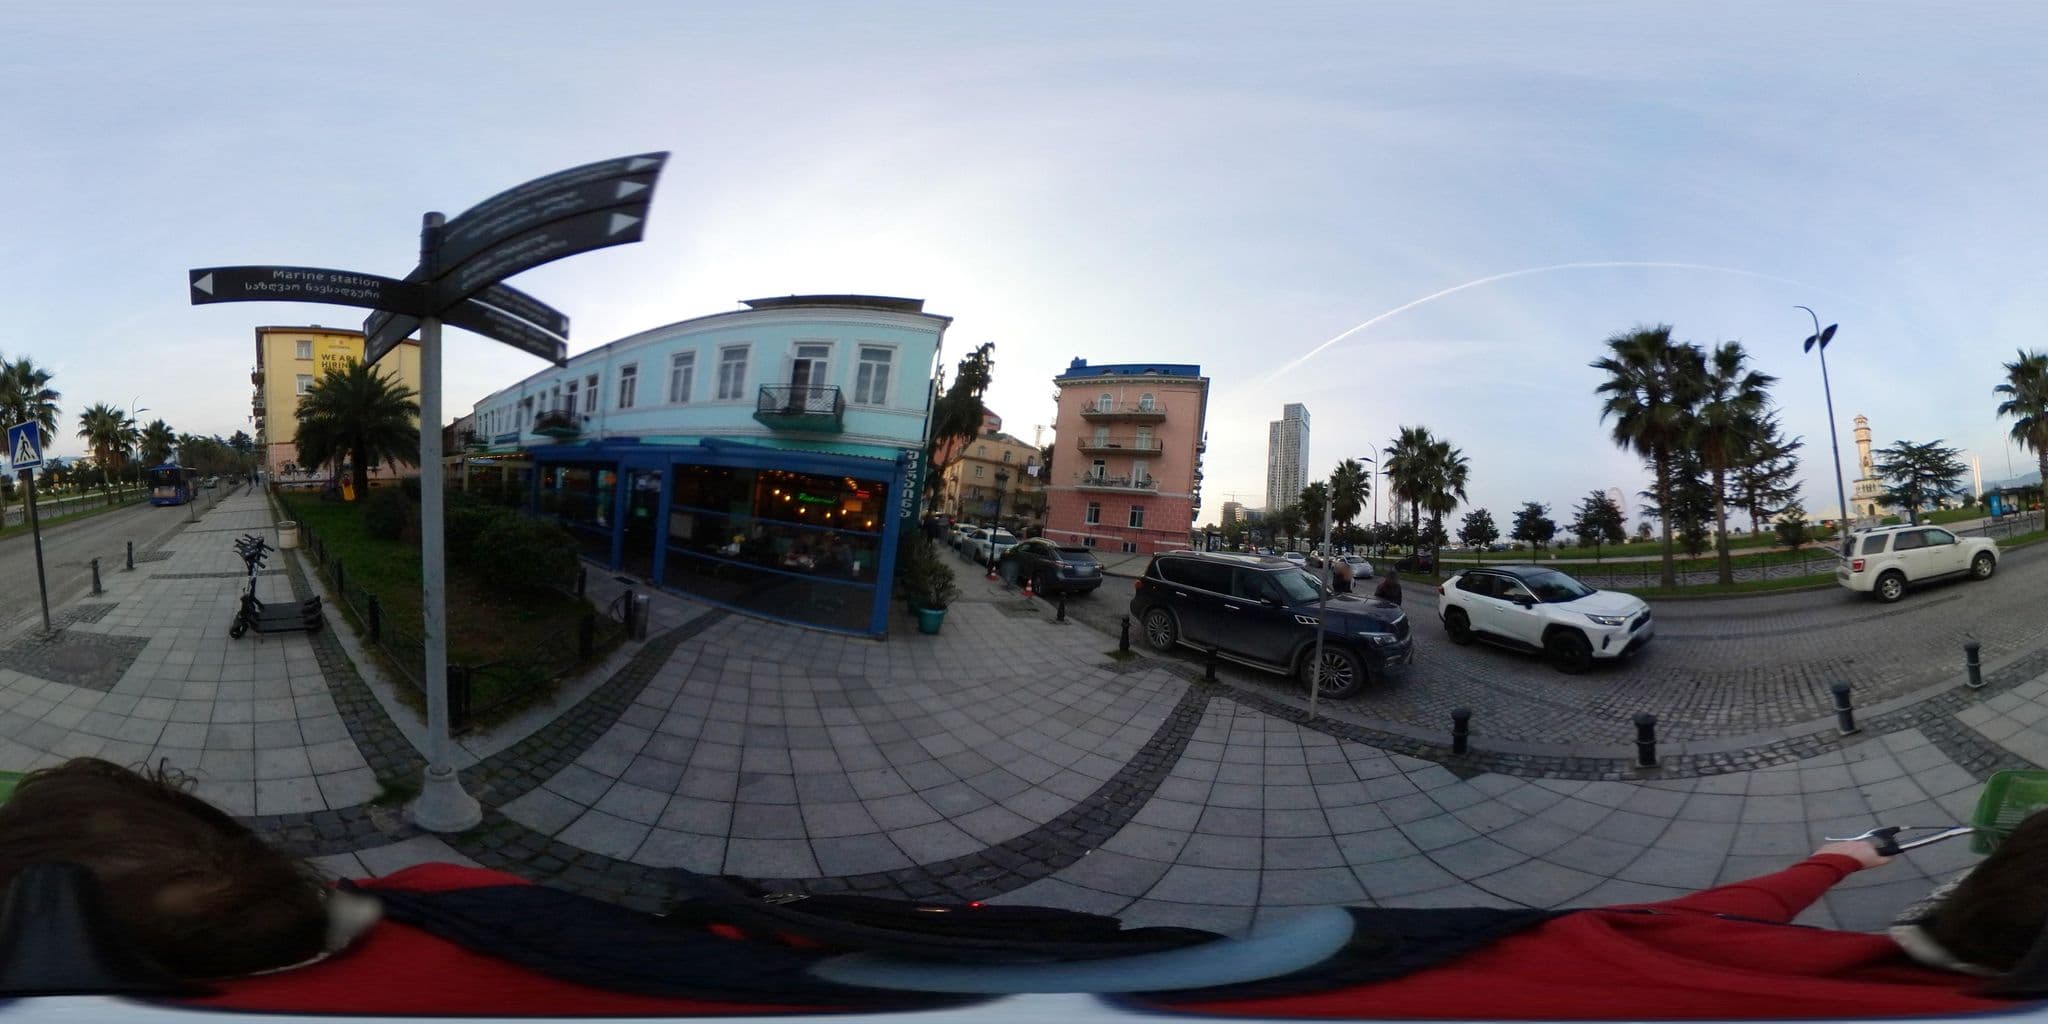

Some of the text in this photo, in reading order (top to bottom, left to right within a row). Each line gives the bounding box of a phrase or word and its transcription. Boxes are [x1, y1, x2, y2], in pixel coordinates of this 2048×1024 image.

[273, 270, 380, 288] Marine station
[245, 282, 380, 299] საზღვაო ნავსადგური
